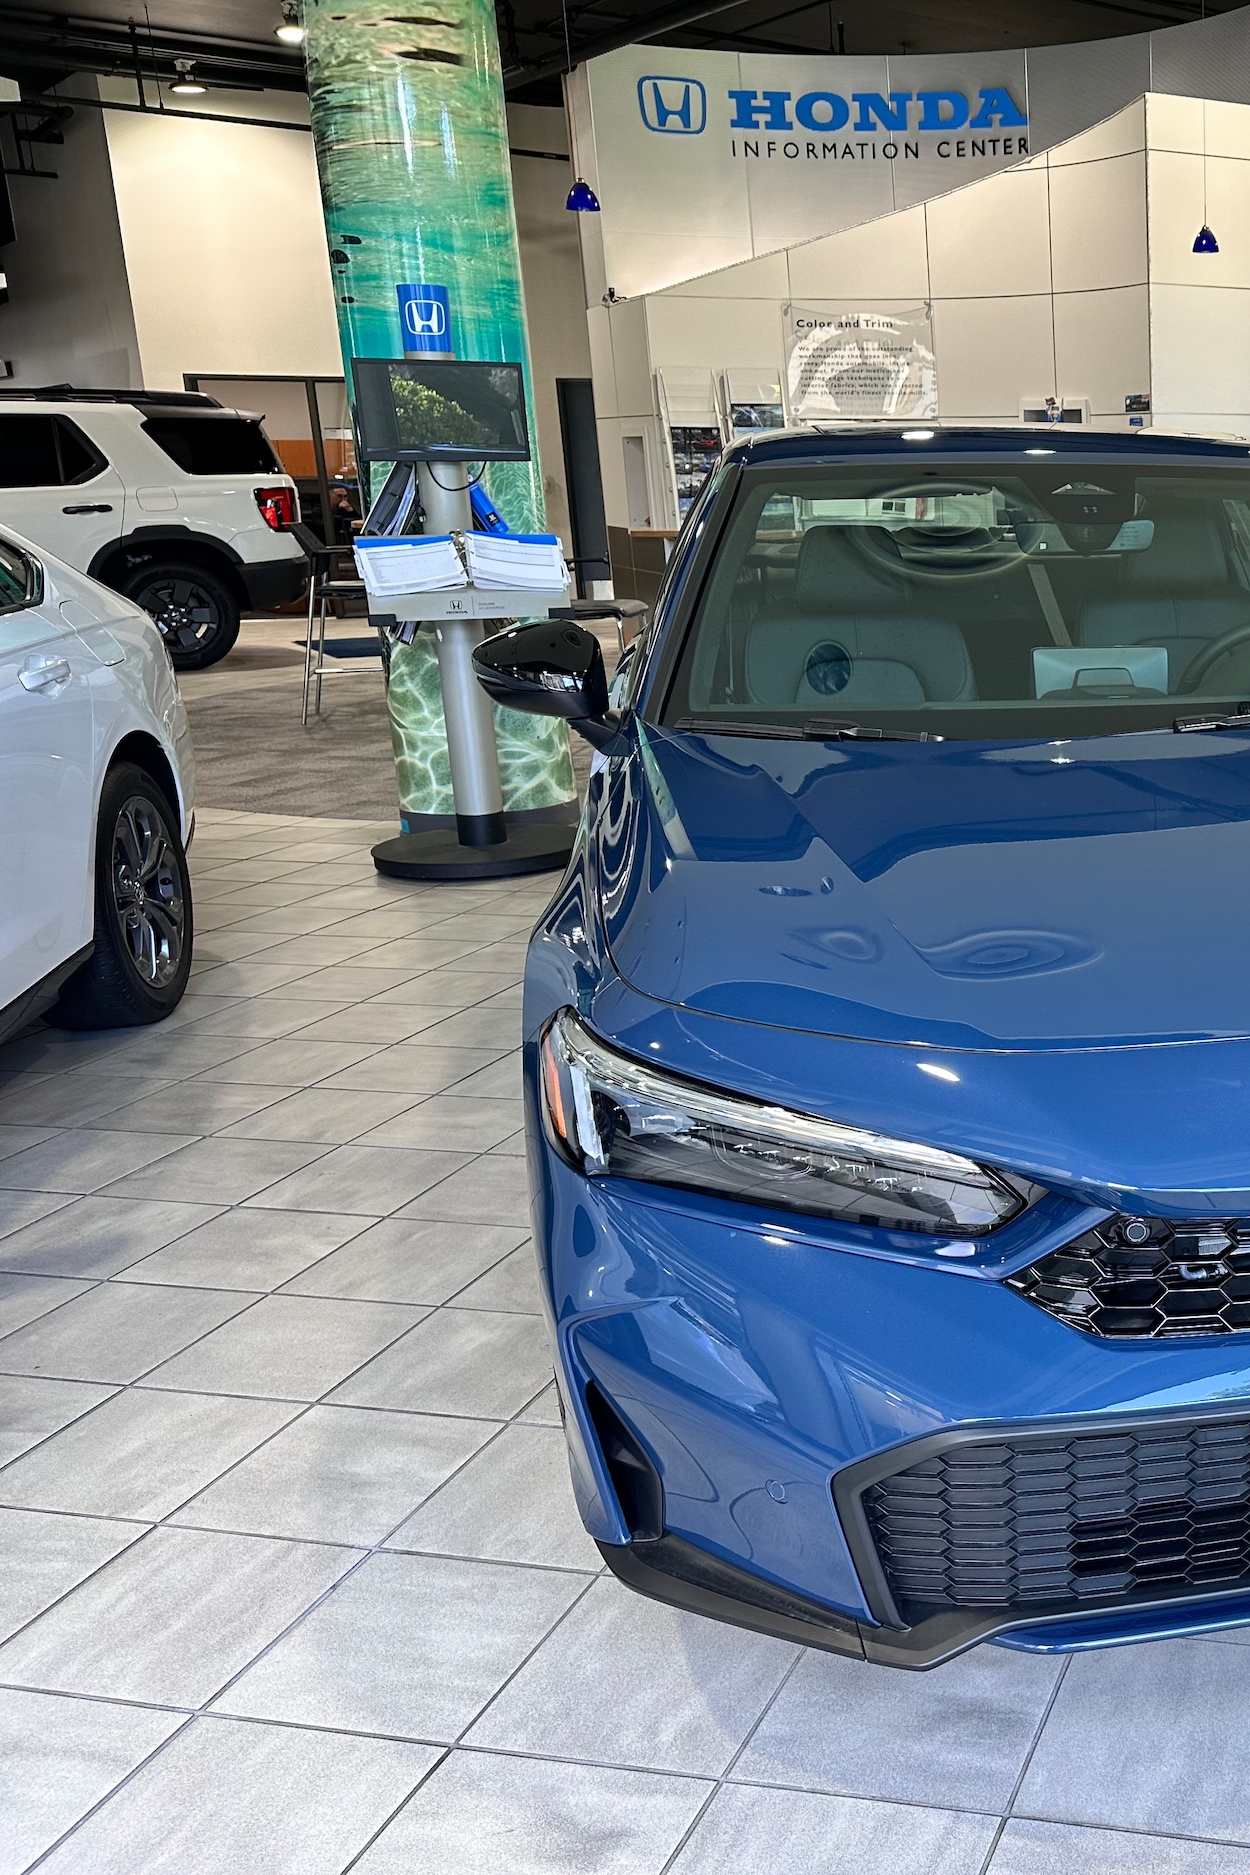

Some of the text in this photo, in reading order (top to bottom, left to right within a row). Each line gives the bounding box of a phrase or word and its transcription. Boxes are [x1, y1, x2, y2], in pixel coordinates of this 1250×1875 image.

[728, 87, 1028, 131] HONDA
[732, 137, 1029, 159] INFORMATION CENTER
[797, 319, 893, 328] Color and Trim
